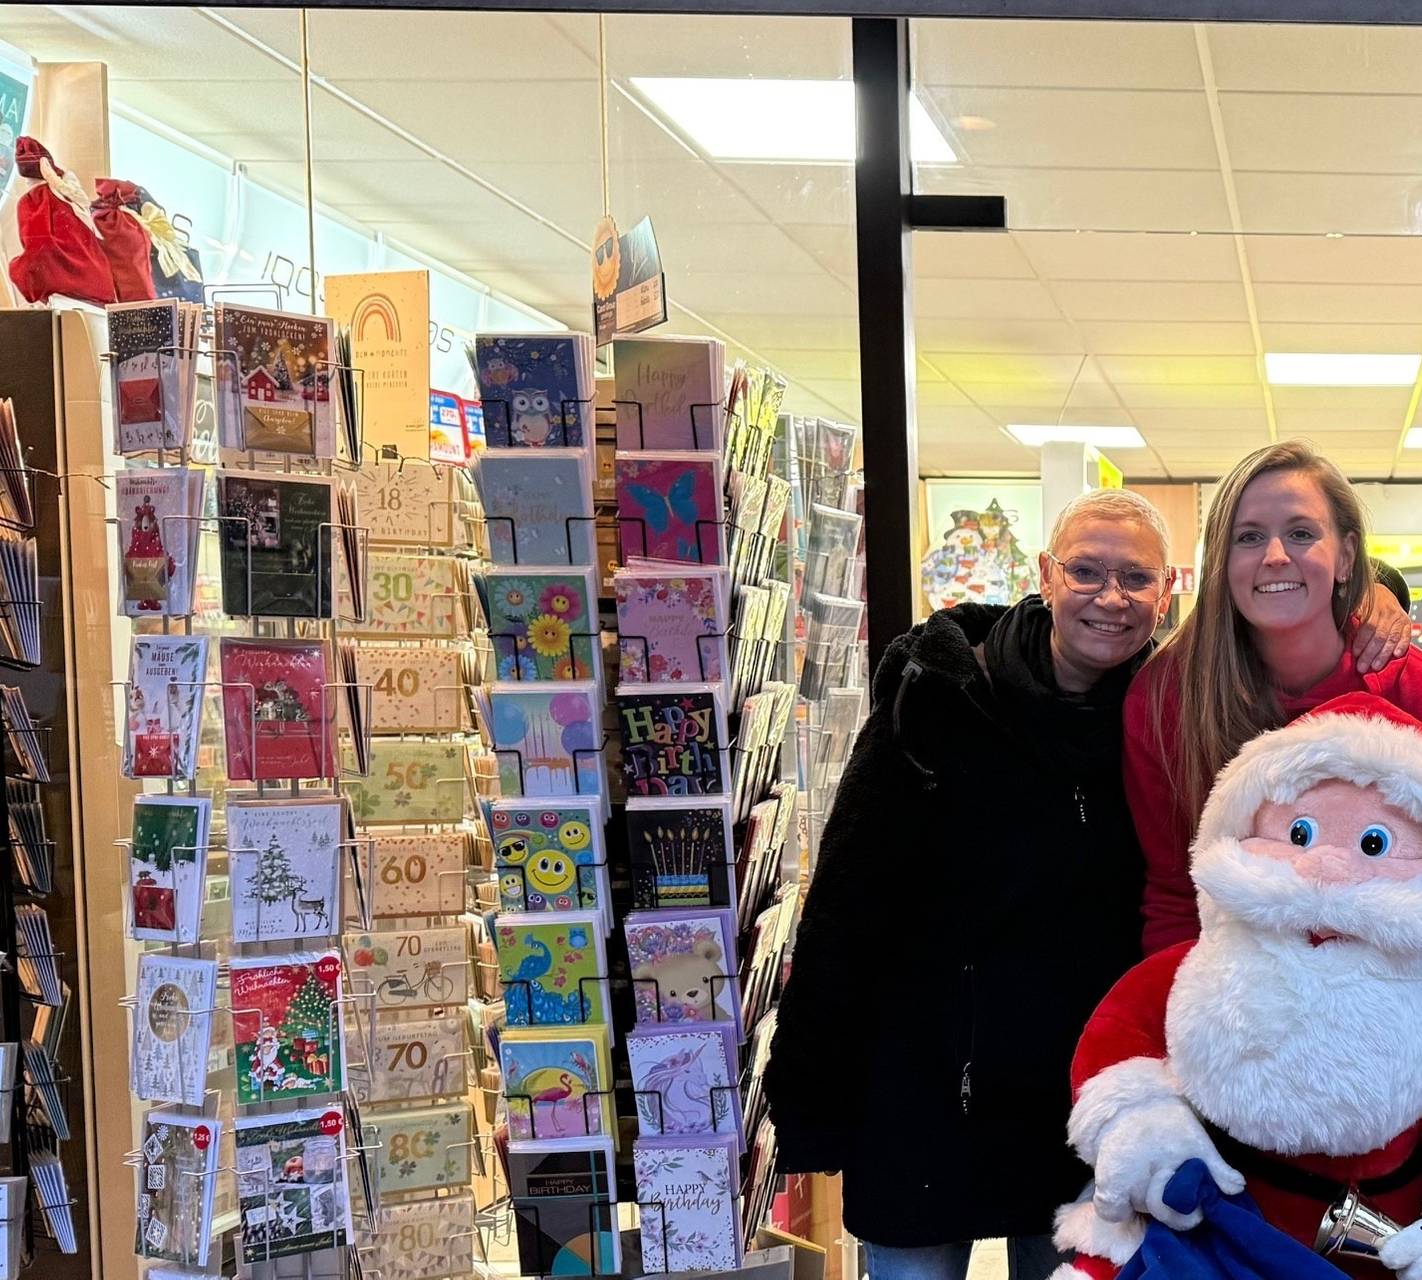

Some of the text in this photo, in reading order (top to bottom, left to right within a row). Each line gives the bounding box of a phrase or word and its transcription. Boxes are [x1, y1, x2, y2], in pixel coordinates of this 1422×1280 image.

[261, 251, 324, 302] IQO
[377, 488, 402, 511] 18
[373, 572, 413, 601] 30
[374, 668, 420, 698] 40
[622, 705, 713, 745] Happy
[384, 761, 429, 791] 50
[380, 854, 427, 885] 60
[395, 935, 422, 957] 70
[317, 963, 335, 974] 1,50
[233, 978, 292, 998] Weihnachten
[387, 1040, 428, 1072] 70
[388, 1131, 434, 1161] 80
[528, 1184, 592, 1195] BIRTHDAY
[544, 1178, 575, 1187] HAPPY
[664, 1183, 707, 1196] HAPPY
[649, 1189, 722, 1215] Birthday
[399, 1222, 434, 1252] 80
